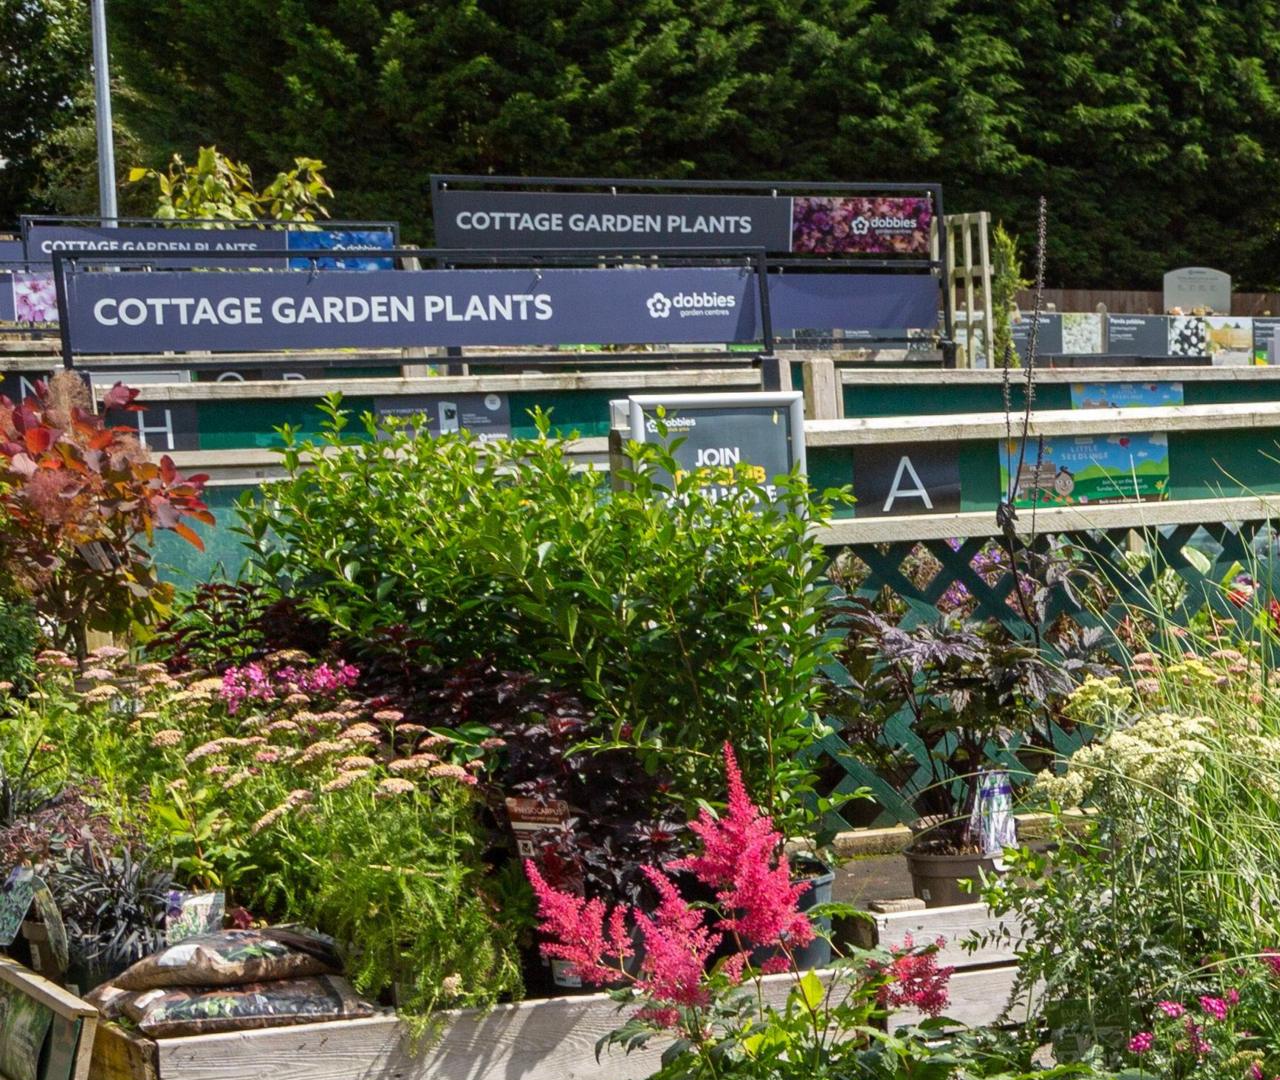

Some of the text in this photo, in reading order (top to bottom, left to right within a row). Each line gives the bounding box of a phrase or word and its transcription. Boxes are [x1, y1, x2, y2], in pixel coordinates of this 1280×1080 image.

[456, 211, 752, 235] COTTAGE GARDEN PLANTS
[871, 216, 917, 228] dobbies
[41, 240, 257, 254] COTTAGE GARDEN PLANTS
[673, 292, 736, 308] dobbies
[94, 293, 553, 327] COTTAGE GARDEN PLANTS
[680, 308, 704, 318] garden
[138, 408, 174, 450] H
[695, 447, 741, 467] JOIN
[1061, 452, 1109, 461] SEEDLINGS
[883, 456, 933, 512] A
